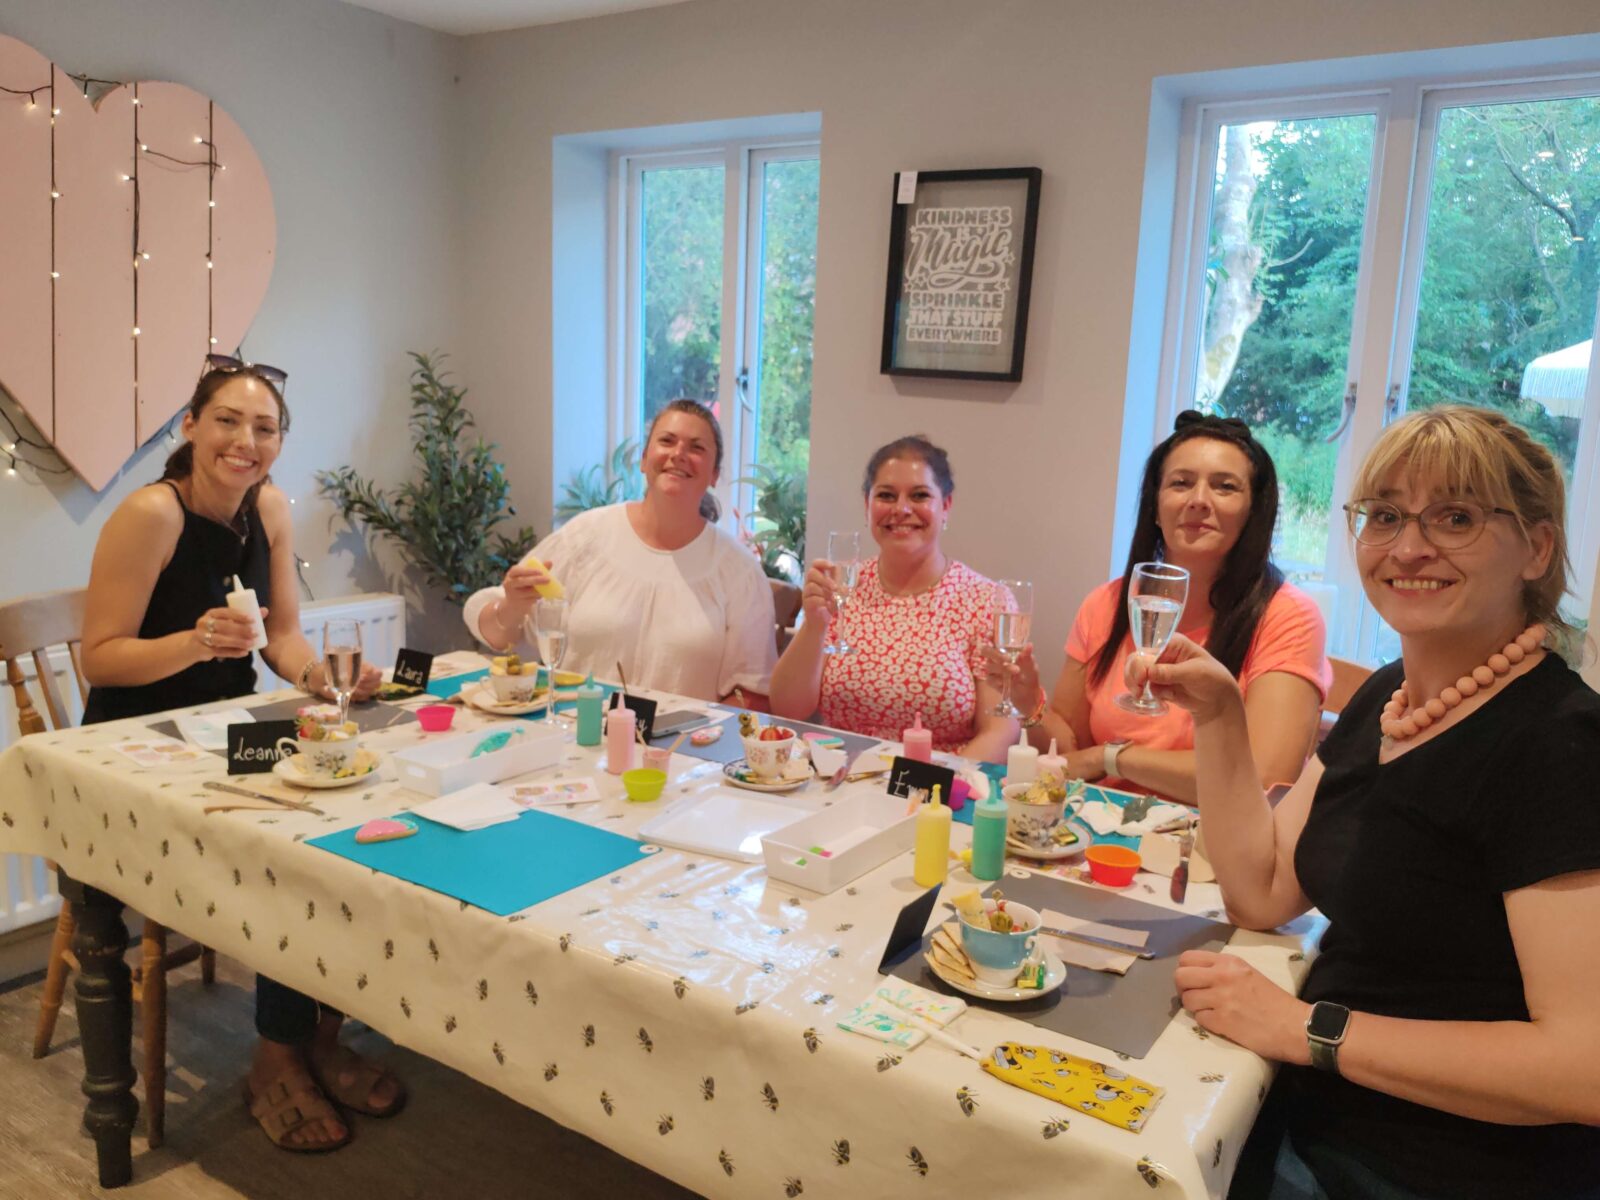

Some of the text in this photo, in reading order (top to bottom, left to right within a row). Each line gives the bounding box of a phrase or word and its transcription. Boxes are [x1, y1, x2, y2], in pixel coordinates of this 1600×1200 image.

[917, 207, 1011, 226] KINDNESS
[906, 227, 1011, 284] Magic
[910, 291, 1004, 310] SPRINKLE
[910, 310, 1002, 328] THAT STUFF
[907, 327, 1001, 343] EVERYWHERE
